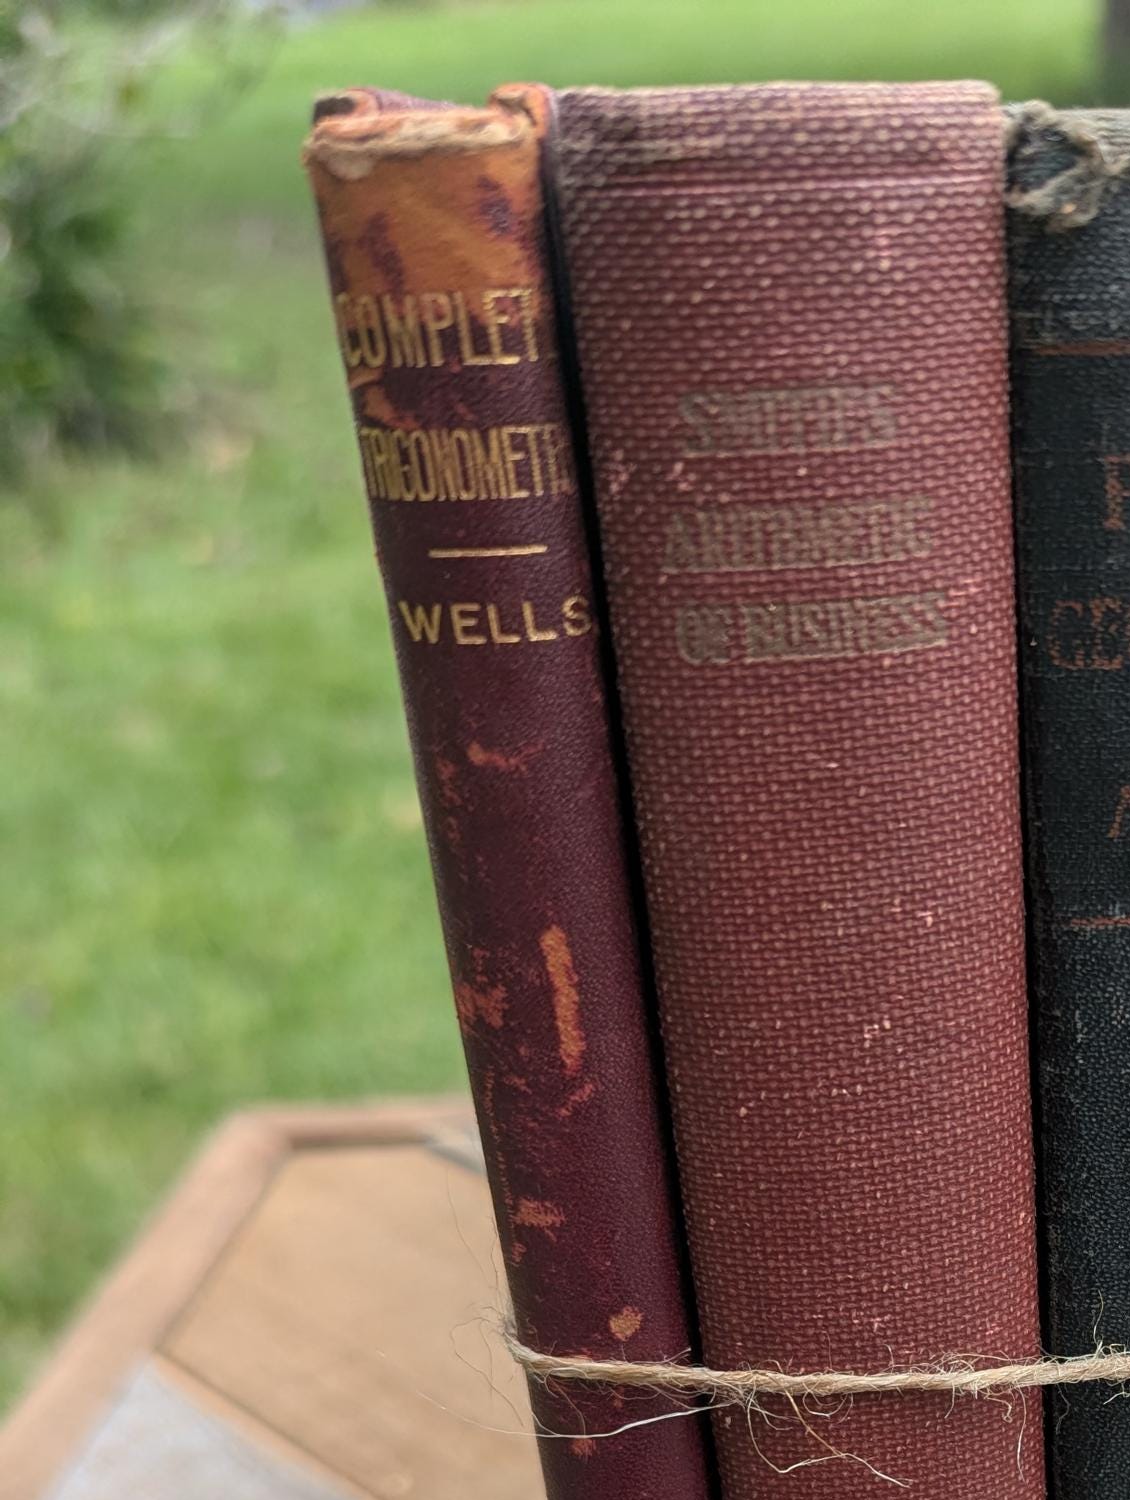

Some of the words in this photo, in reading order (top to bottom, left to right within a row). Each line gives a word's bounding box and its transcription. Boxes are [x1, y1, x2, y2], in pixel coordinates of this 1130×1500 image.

[335, 288, 540, 368] COMPLET
[360, 422, 574, 501] TRIGONOMETR
[400, 596, 593, 645] WELLS
[743, 591, 951, 663] BUSINESS
